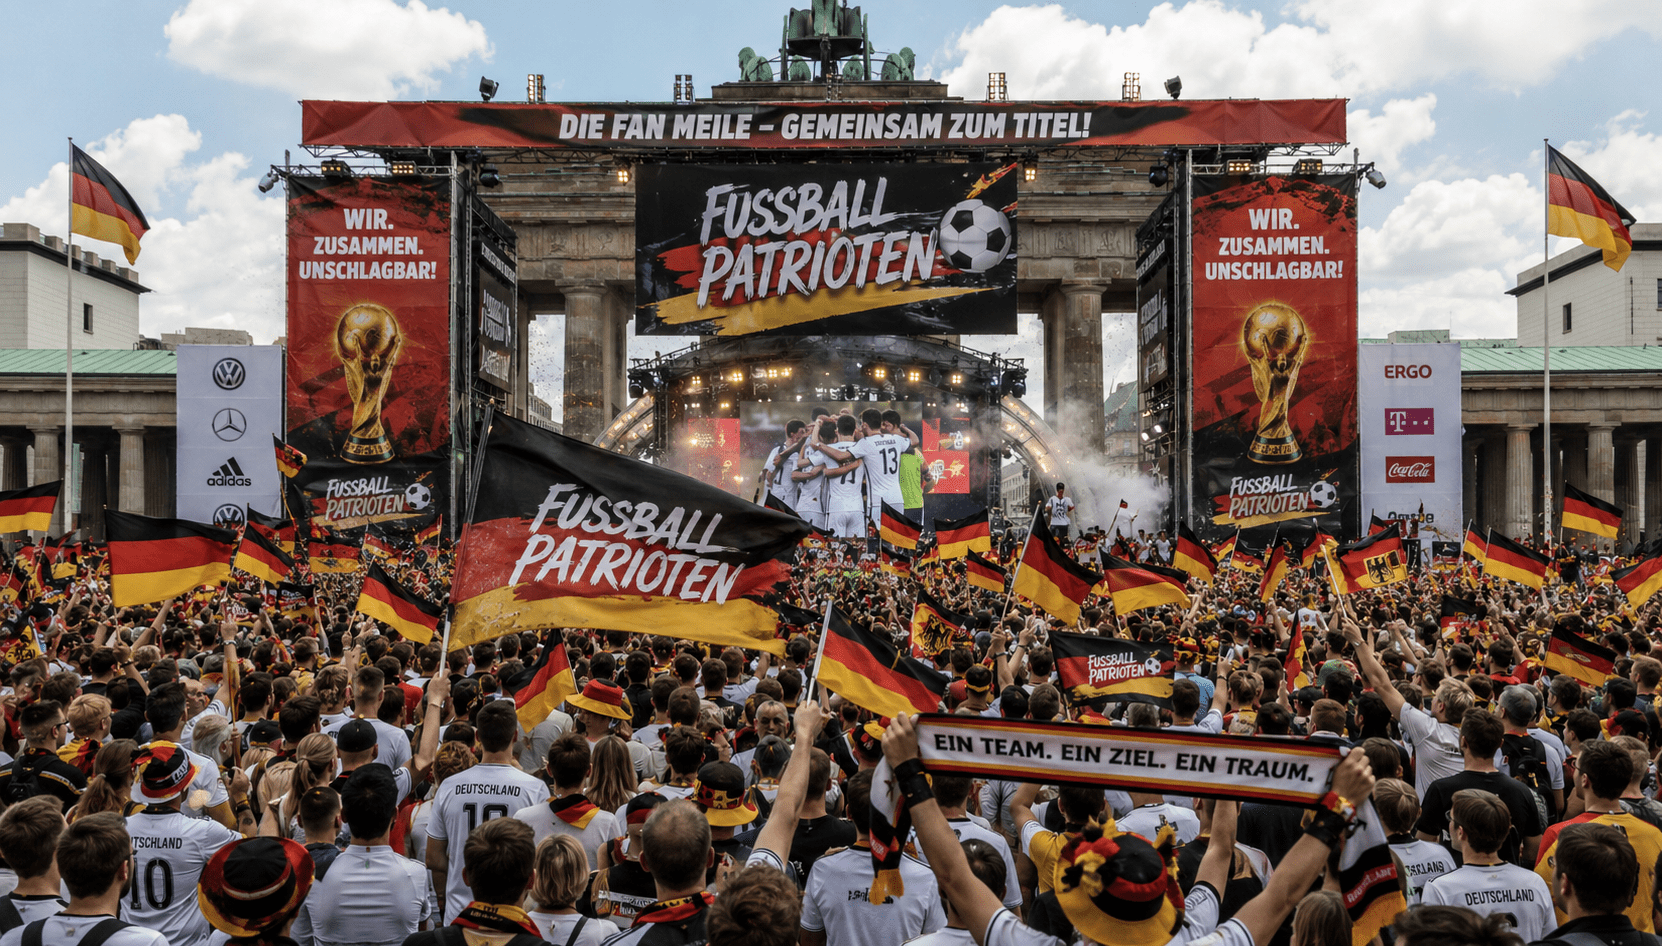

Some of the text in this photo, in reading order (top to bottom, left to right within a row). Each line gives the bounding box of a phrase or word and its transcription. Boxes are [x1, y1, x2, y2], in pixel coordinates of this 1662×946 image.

[559, 114, 603, 139] DIE
[610, 114, 667, 139] FAN
[672, 114, 752, 139] MEILE
[781, 113, 941, 139] GEMEINSAM
[948, 113, 1009, 138] ZUM
[1012, 112, 1092, 138] TITEL!
[343, 208, 394, 230] WIR.
[699, 176, 898, 246] FUSSBALL
[1248, 208, 1300, 230] WIR.
[313, 236, 424, 255] ZUSAMMEN.
[1218, 235, 1330, 255] ZUSAMMEN.
[299, 261, 437, 280] UNSCHLAGBAR!
[696, 229, 940, 309] PATRIOTEN
[1205, 260, 1344, 280] UNSCHLAGBAR!
[1384, 364, 1432, 379] ERGO
[879, 447, 898, 475] 13
[206, 475, 252, 487] adidas
[326, 475, 393, 501] FUSSBALL
[1229, 473, 1298, 499] FUSSBALL
[324, 494, 406, 521] PATRIOTEN
[1228, 491, 1310, 518] PATRIOTEN
[529, 482, 740, 554] FUSSBALL
[507, 533, 746, 605] PATRIOTEN
[1087, 651, 1138, 671] FUSSBALL
[1088, 664, 1145, 685] PATRIOTEN
[934, 732, 1314, 782] EIN TEAM. EIN ZIEL. EIN TRAUM.
[455, 783, 521, 797] DEUTSCHLAND
[131, 836, 183, 850] TSCHLAND
[130, 857, 174, 911] 10
[1464, 888, 1535, 906] DEUTSCHLAND
